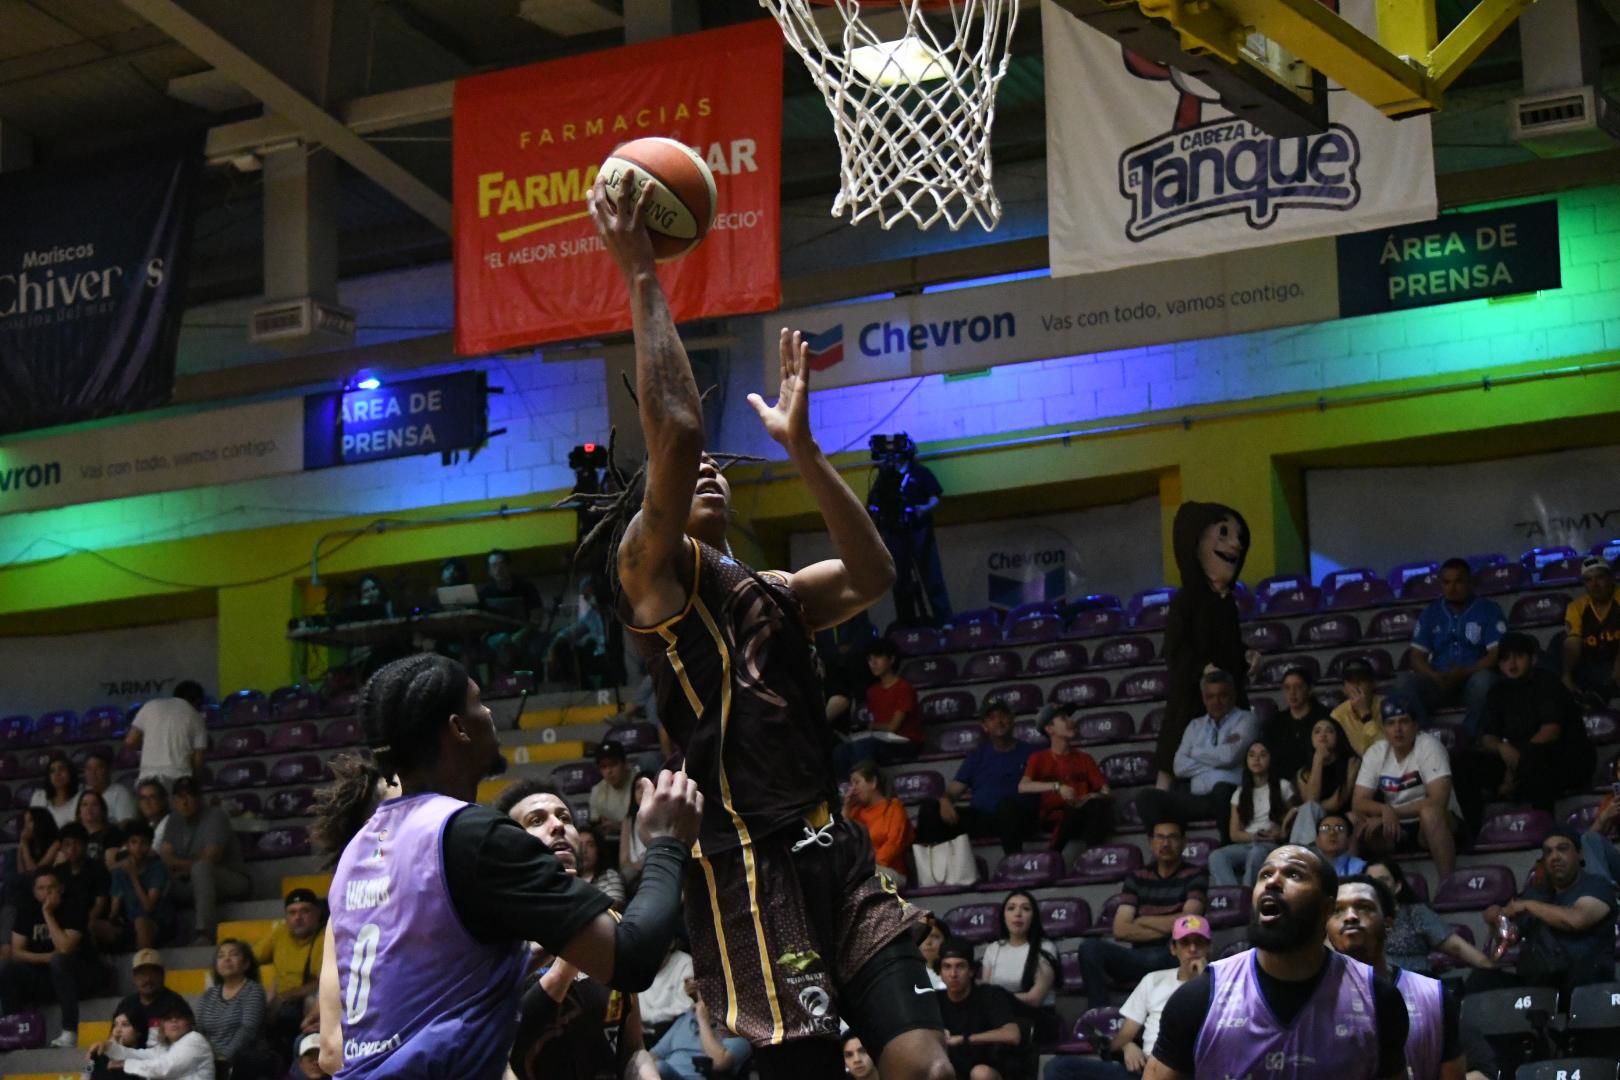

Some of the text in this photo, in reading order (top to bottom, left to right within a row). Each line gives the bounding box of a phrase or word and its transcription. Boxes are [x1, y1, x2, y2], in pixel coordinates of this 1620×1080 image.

[519, 97, 713, 150] FARMACIAS
[1180, 123, 1246, 151] CABEZA
[478, 137, 759, 219] FARMAAR
[1128, 132, 1350, 218] Tanque
[1128, 171, 1141, 188] EL
[604, 169, 678, 230] SPNG
[507, 243, 556, 265] MEJOR
[559, 239, 610, 257] SURTI
[1380, 223, 1518, 265] ÁREA DE
[22, 242, 96, 269] Mariscos
[1388, 261, 1513, 301] PRENSA
[1041, 281, 1305, 332] Vas con todo, vamos contigo.
[859, 311, 1016, 357] Chevron
[410, 390, 442, 414] DE
[342, 424, 436, 456] PRENSA
[107, 461, 131, 477] con
[1254, 627, 1268, 637] 41
[99, 677, 176, 697] ARMY
[1509, 821, 1526, 833] 47
[1101, 855, 1118, 866] 42
[1182, 846, 1198, 858] 43
[1024, 860, 1039, 872] 41
[1468, 876, 1486, 890] 47
[1211, 896, 1228, 909] 44
[969, 914, 985, 926] 41
[1051, 908, 1068, 921] 42
[1514, 995, 1532, 1010] 46
[1570, 1069, 1582, 1080] 4
